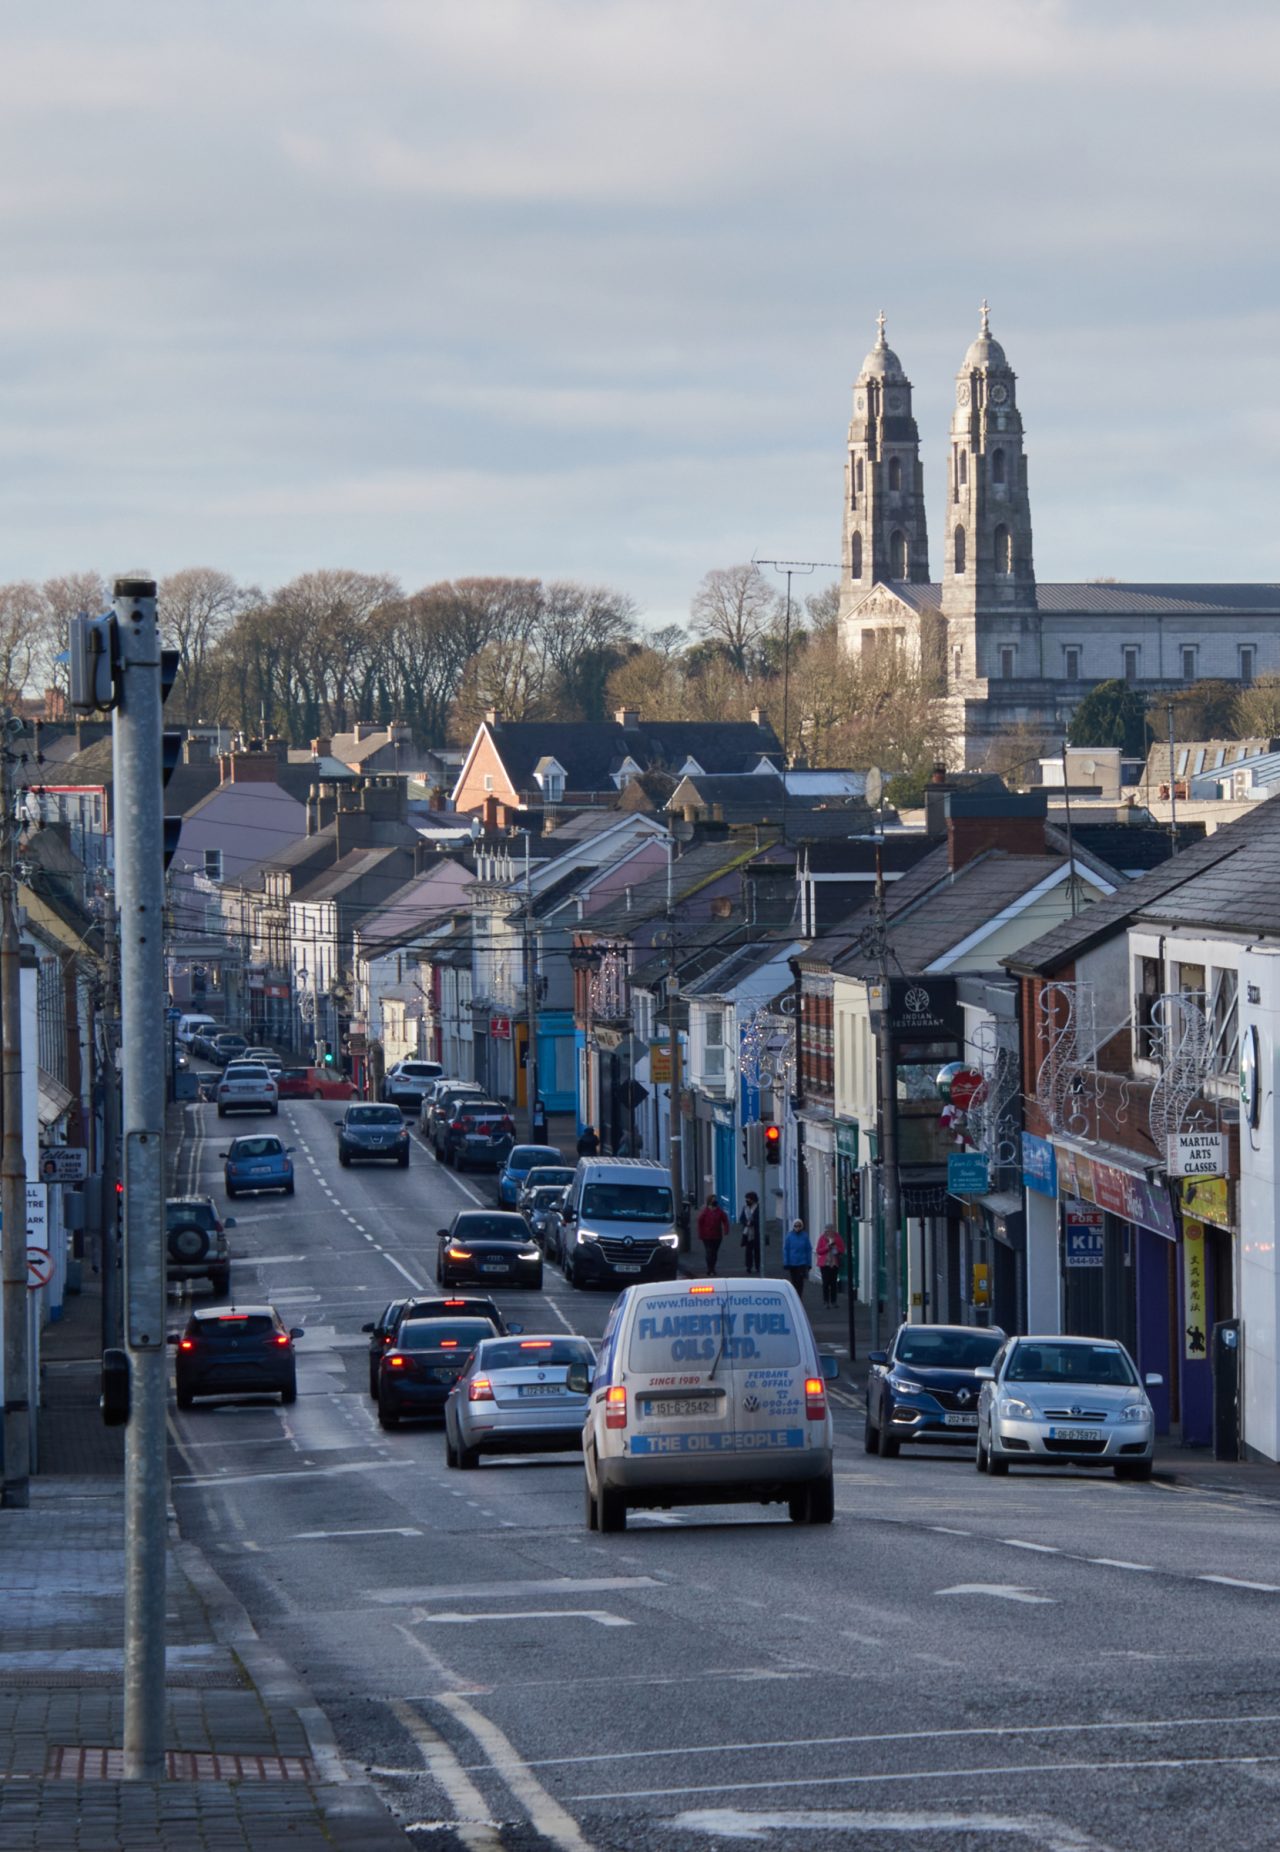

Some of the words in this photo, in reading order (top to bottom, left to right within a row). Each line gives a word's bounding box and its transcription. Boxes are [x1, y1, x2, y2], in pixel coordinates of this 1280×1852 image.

[1179, 1136, 1220, 1147] MARTIAL
[1189, 1149, 1212, 1160] ARTS
[1184, 1161, 1218, 1173] CLASSES
[1071, 1214, 1097, 1223] FOR
[646, 1295, 782, 1311] www.flahertyfuel.com
[639, 1312, 738, 1341] FLAHERTY
[743, 1312, 790, 1336] FUEL
[671, 1338, 715, 1362] OILS
[721, 1337, 760, 1360] LTD.
[748, 1370, 789, 1379] FERBANE
[649, 1376, 676, 1386] SINCE
[679, 1375, 701, 1385] 1989
[761, 1379, 794, 1388] OFFALY
[656, 1400, 711, 1415] 151-G-2542
[647, 1437, 682, 1451] THE
[687, 1435, 716, 1449] OIL
[721, 1432, 788, 1448] PEOPLE
